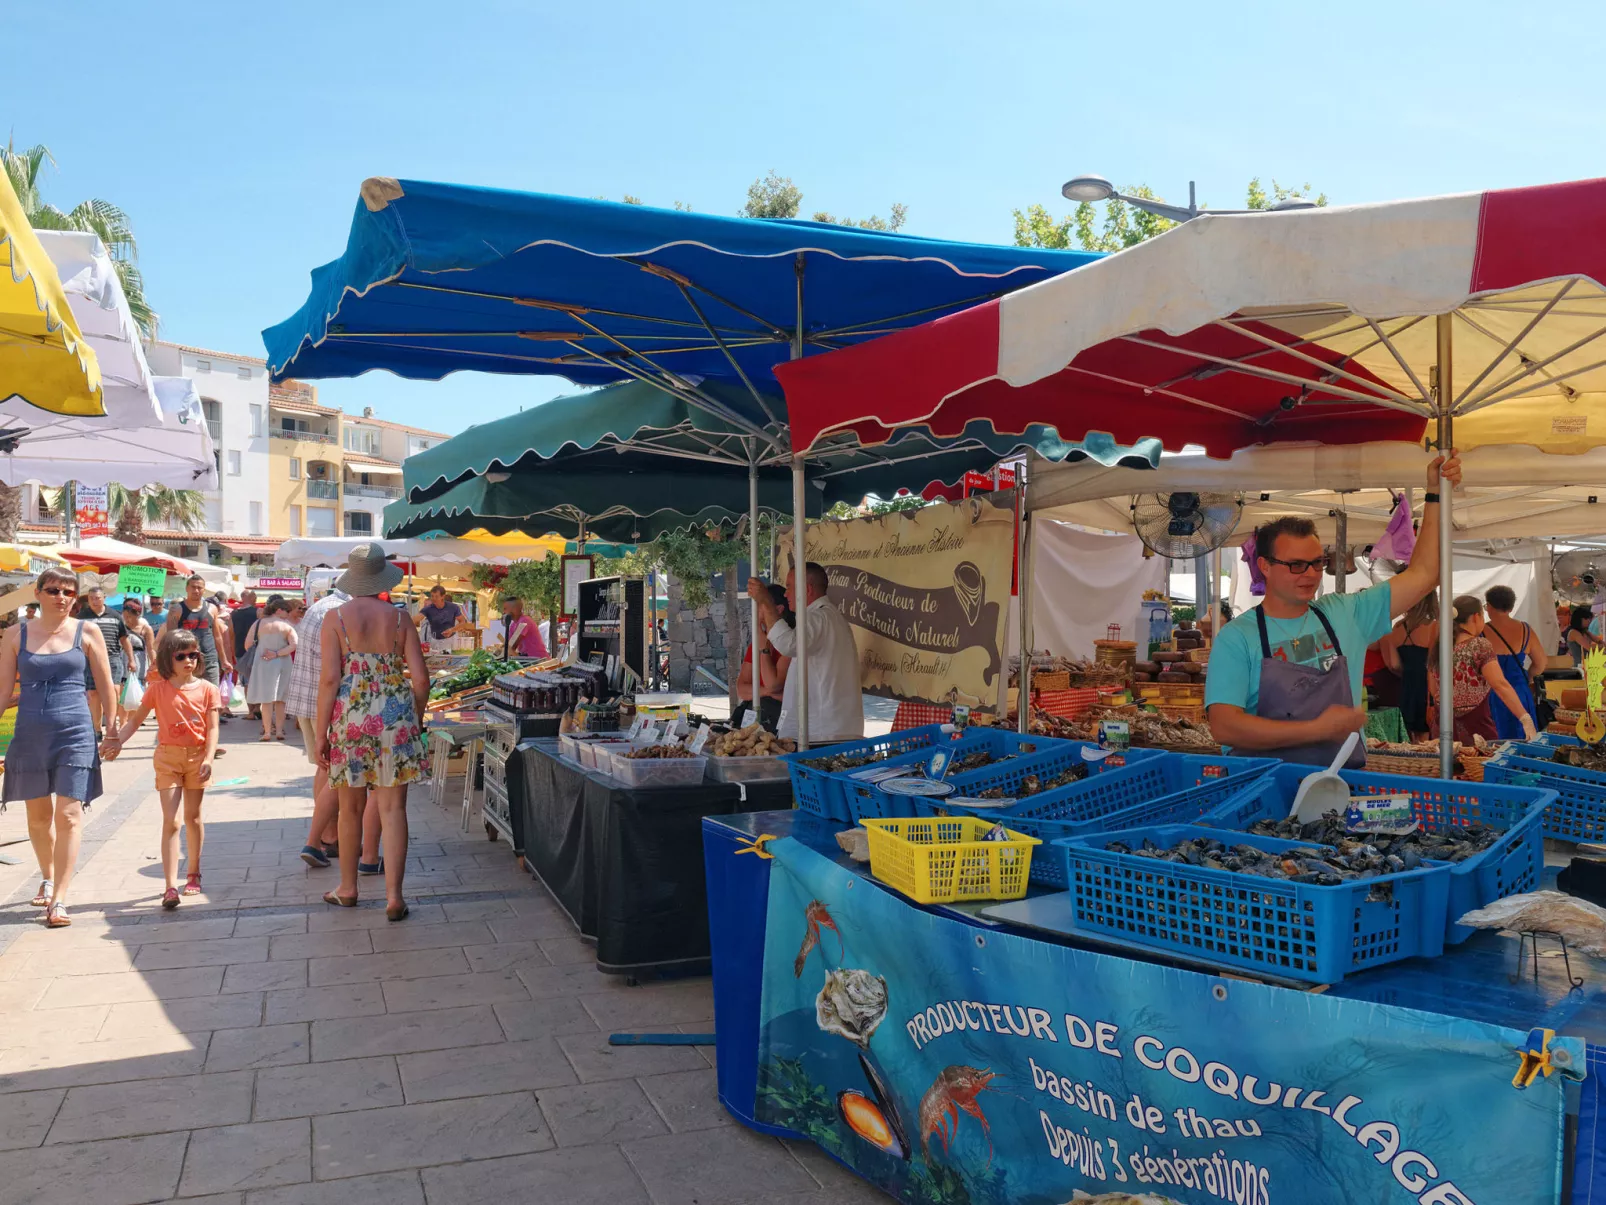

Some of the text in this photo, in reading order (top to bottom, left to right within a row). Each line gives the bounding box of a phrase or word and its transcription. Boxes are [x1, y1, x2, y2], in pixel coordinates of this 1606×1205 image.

[122, 566, 164, 574] PROMOTION
[124, 586, 142, 594] 10
[853, 571, 915, 611] Producteur
[921, 592, 938, 613] de
[905, 620, 960, 648] Naturels
[906, 1000, 1058, 1050] PRODUCTEUR
[1064, 1013, 1122, 1058] DE
[1028, 1057, 1262, 1138] bassin de thau
[1039, 1109, 1271, 1205] Depuis 3 générations
